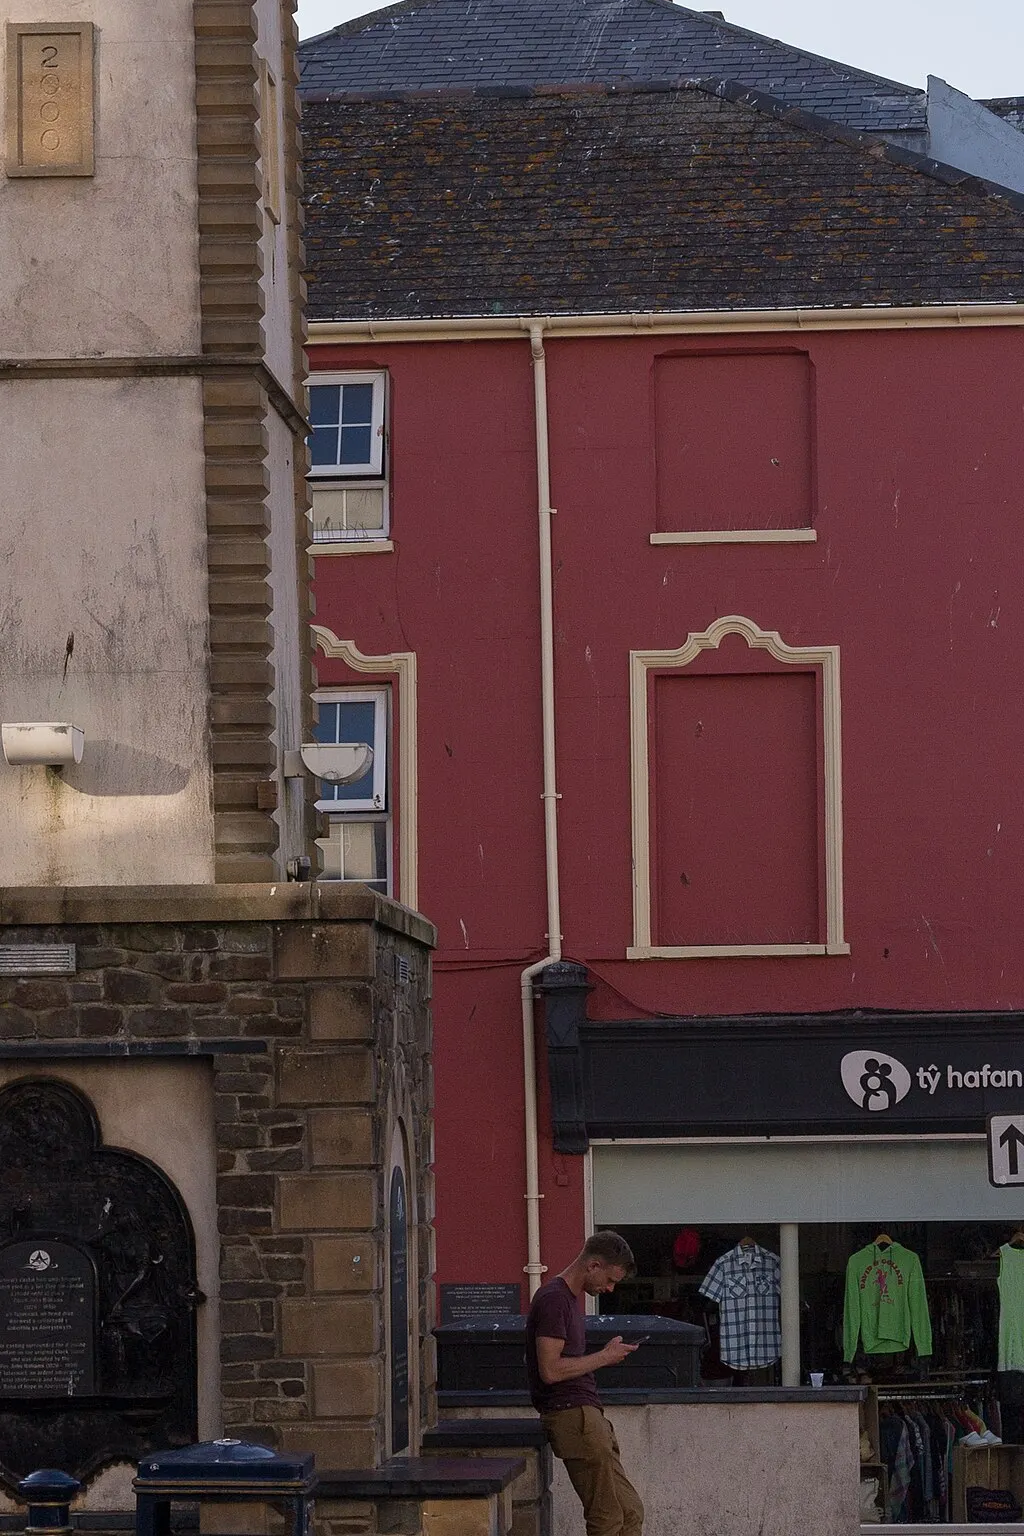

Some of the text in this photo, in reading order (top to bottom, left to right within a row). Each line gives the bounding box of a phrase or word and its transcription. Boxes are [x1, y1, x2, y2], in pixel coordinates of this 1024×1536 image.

[916, 1063, 1022, 1095] tŷ hafan
[860, 1265, 873, 1290] DAVID
